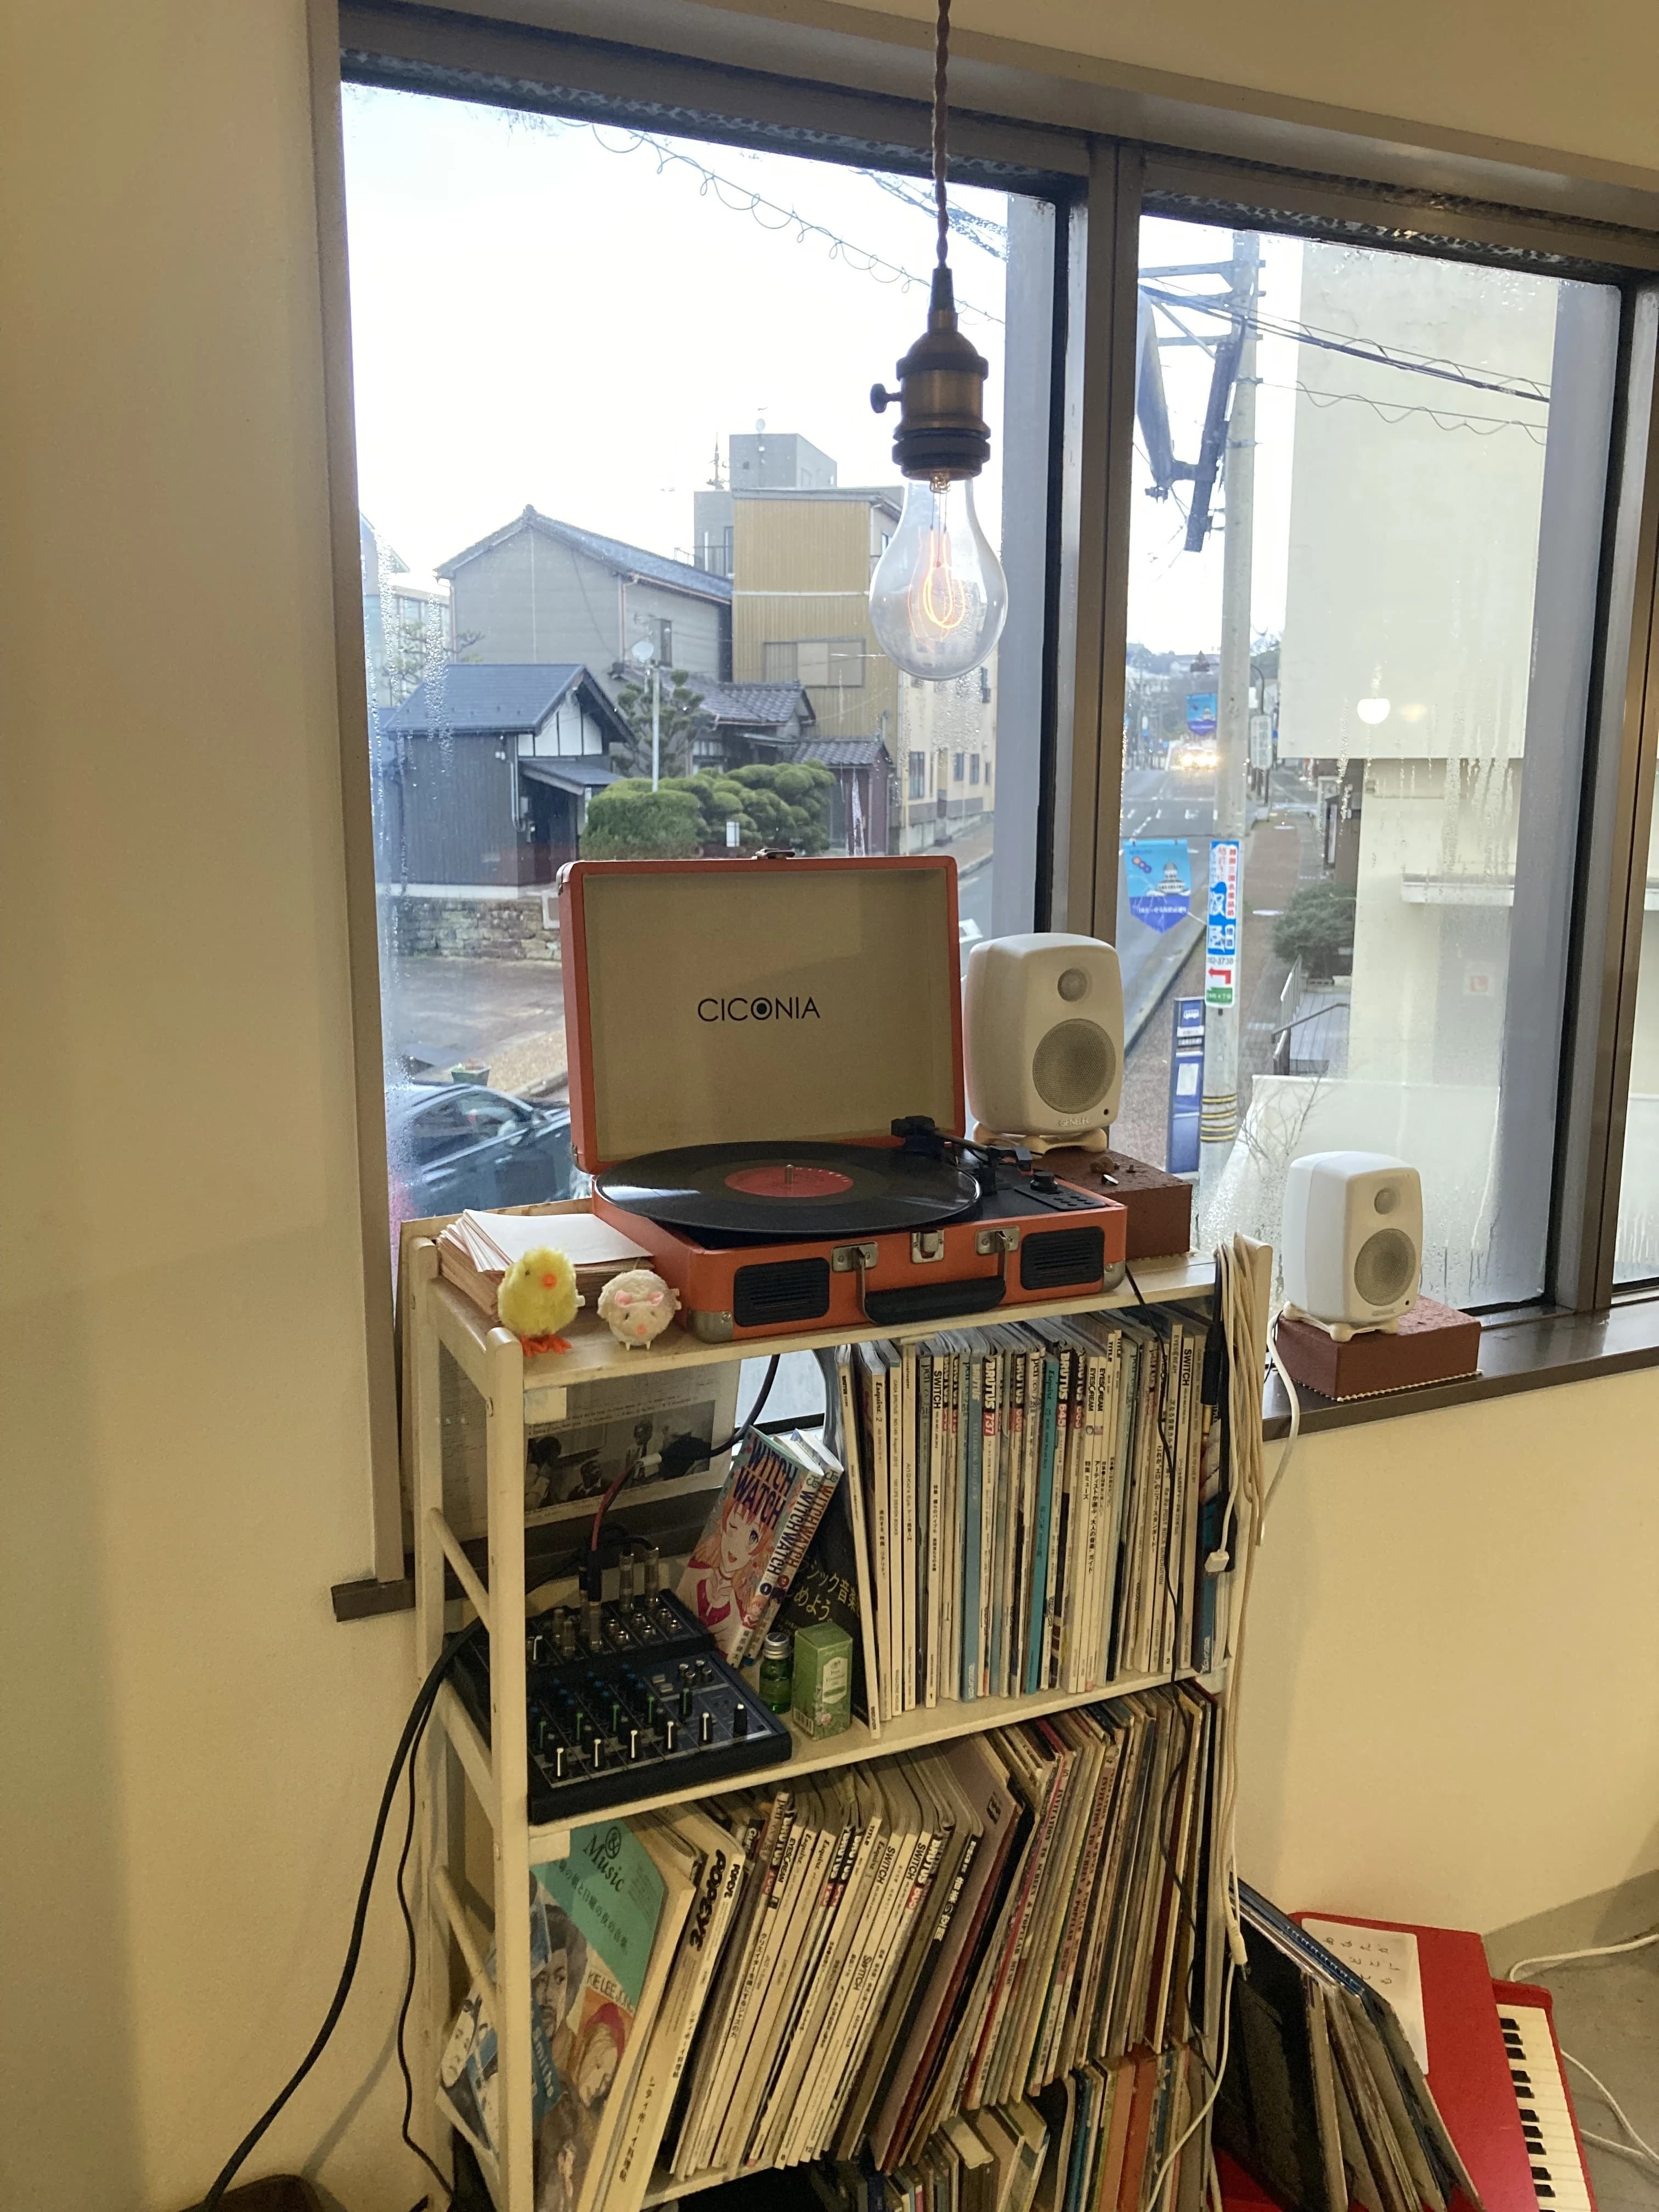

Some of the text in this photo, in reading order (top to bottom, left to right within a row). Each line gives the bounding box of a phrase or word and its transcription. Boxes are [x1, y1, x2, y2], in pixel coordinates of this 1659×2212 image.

[698, 996, 821, 1022] CICONIA
[983, 1359, 997, 1409] BRUTUS
[1014, 1357, 1024, 1404] BRUTUS
[1181, 1348, 1192, 1386] SWITCH
[874, 1382, 883, 1413] Esquire
[932, 1370, 943, 1409] SWITCH
[1057, 1352, 1071, 1426] BRUTUS 645
[984, 1413, 995, 1435] 737
[747, 1438, 799, 1497] WITCH
[733, 1467, 787, 1530] WATCH
[863, 1824, 876, 1846] TITLE
[1043, 1788, 1063, 1841] INVITATION
[771, 1815, 793, 1867] BRUTUS
[795, 1832, 812, 1865] Esquire
[813, 1838, 831, 1871] Esquire
[868, 1839, 885, 1871] Esquire
[905, 1841, 927, 1882] SWITCH
[916, 1838, 941, 1885] BRUTUS
[583, 1833, 625, 1893] Music
[723, 1863, 742, 1899] POPEYE
[875, 1844, 896, 1886] SWITCH
[686, 1848, 729, 1953] POPEYE
